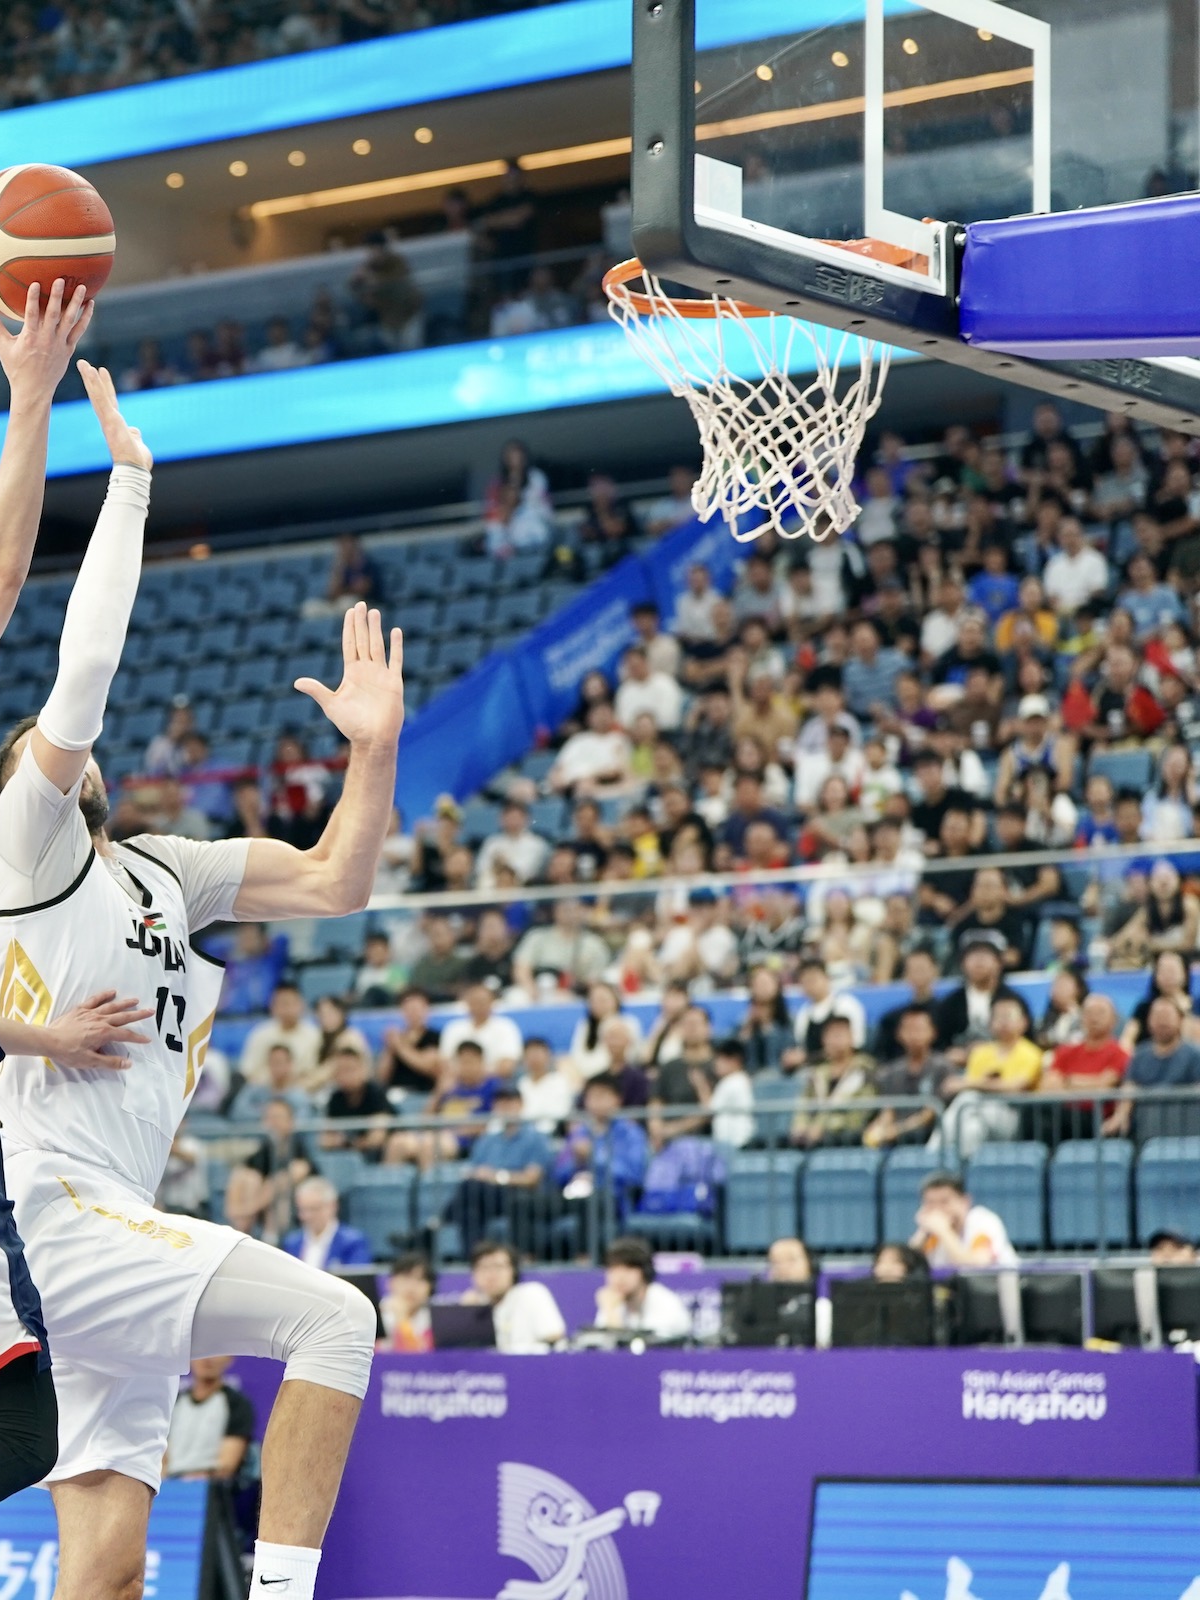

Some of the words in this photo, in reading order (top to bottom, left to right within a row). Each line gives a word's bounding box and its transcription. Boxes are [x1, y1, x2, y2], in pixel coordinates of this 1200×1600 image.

[155, 986, 187, 1053] 13
[659, 1390, 798, 1424] Hangzhou
[961, 1390, 1108, 1426] Hangzhou
